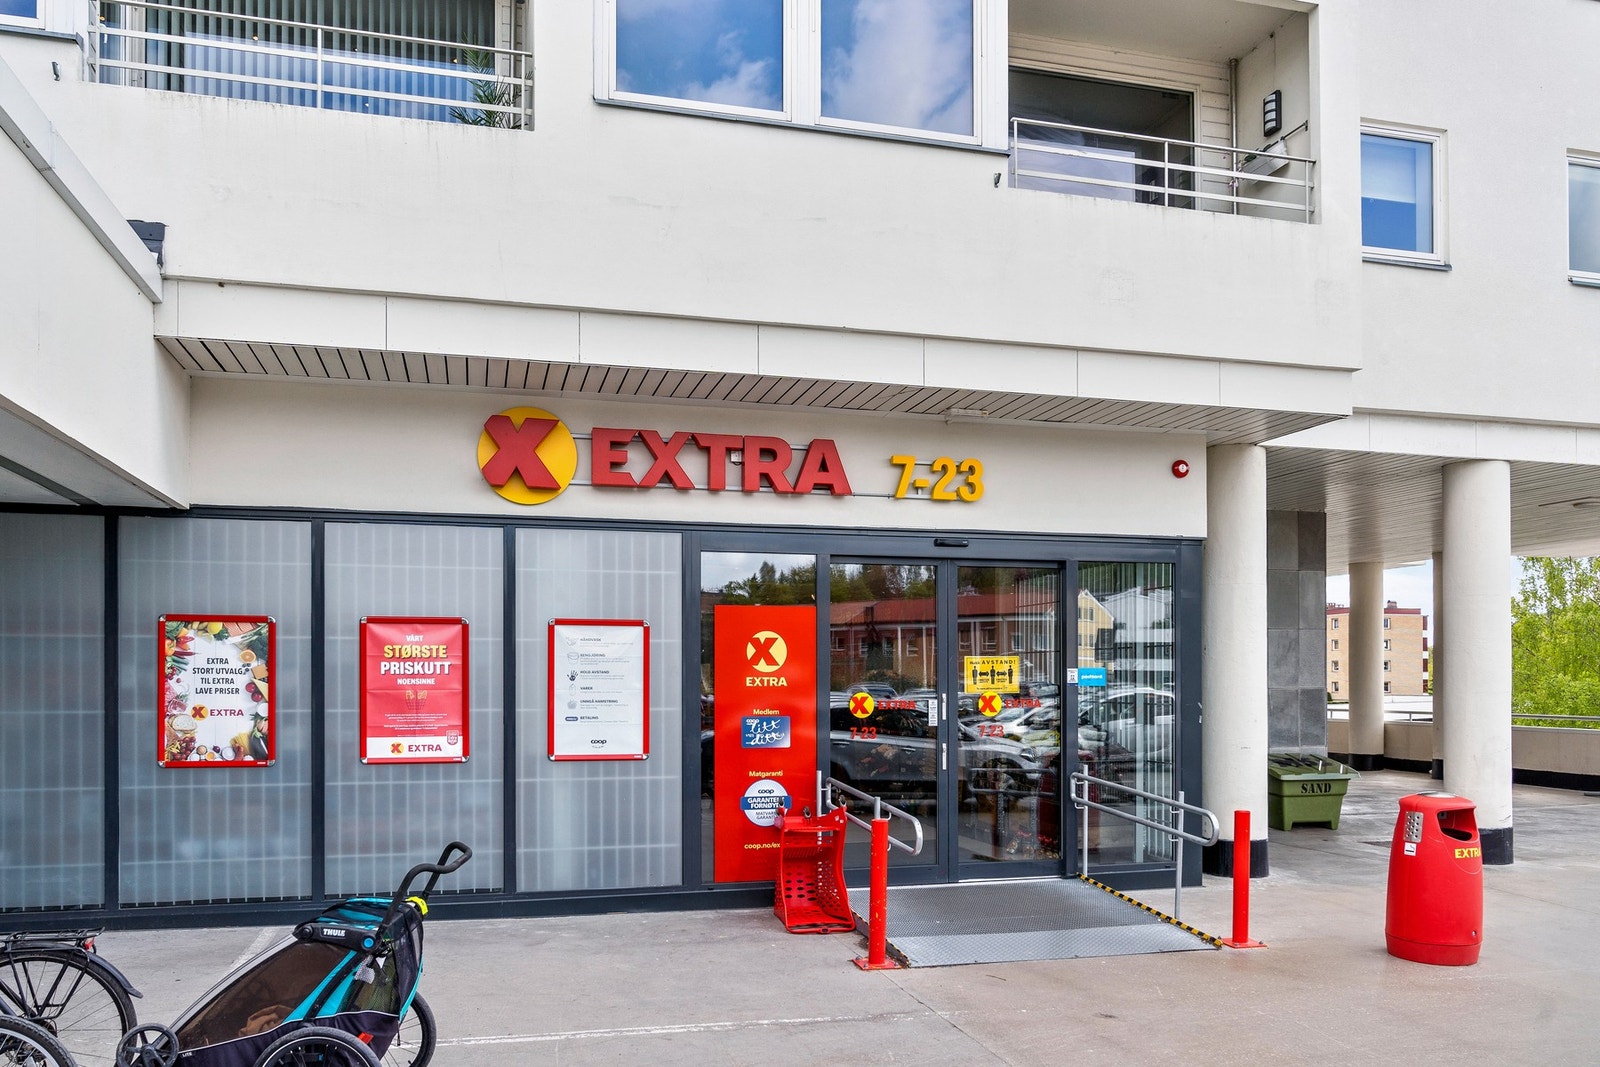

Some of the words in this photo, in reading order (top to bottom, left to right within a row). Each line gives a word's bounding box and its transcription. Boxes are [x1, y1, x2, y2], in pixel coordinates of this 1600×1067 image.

[591, 427, 853, 497] EXTRA
[889, 454, 985, 503] 7-23
[405, 634, 424, 642] VÅRT
[383, 644, 448, 659] STØRSTE
[206, 657, 230, 665] EXTRA
[192, 667, 215, 675] STORT
[215, 667, 243, 675] UTVALG
[380, 661, 452, 675] PRISKUTT
[200, 677, 212, 685] TIL
[212, 677, 235, 685] EXTRA
[745, 676, 788, 687] EXTRA
[195, 687, 213, 695] LAVE
[214, 687, 240, 695] PRISER
[877, 699, 917, 710] EXTRA
[1005, 698, 1042, 708] EXTRA
[209, 709, 245, 717] EXTRA
[850, 726, 878, 740] 7-23
[977, 724, 1005, 737] 7-23
[407, 744, 443, 752] EXTRA
[748, 770, 784, 778] Matgaranti
[1300, 783, 1332, 793] SAND
[744, 842, 781, 850] coop.no/ex
[1454, 847, 1481, 859] EXTR
[322, 928, 346, 937] THULE
